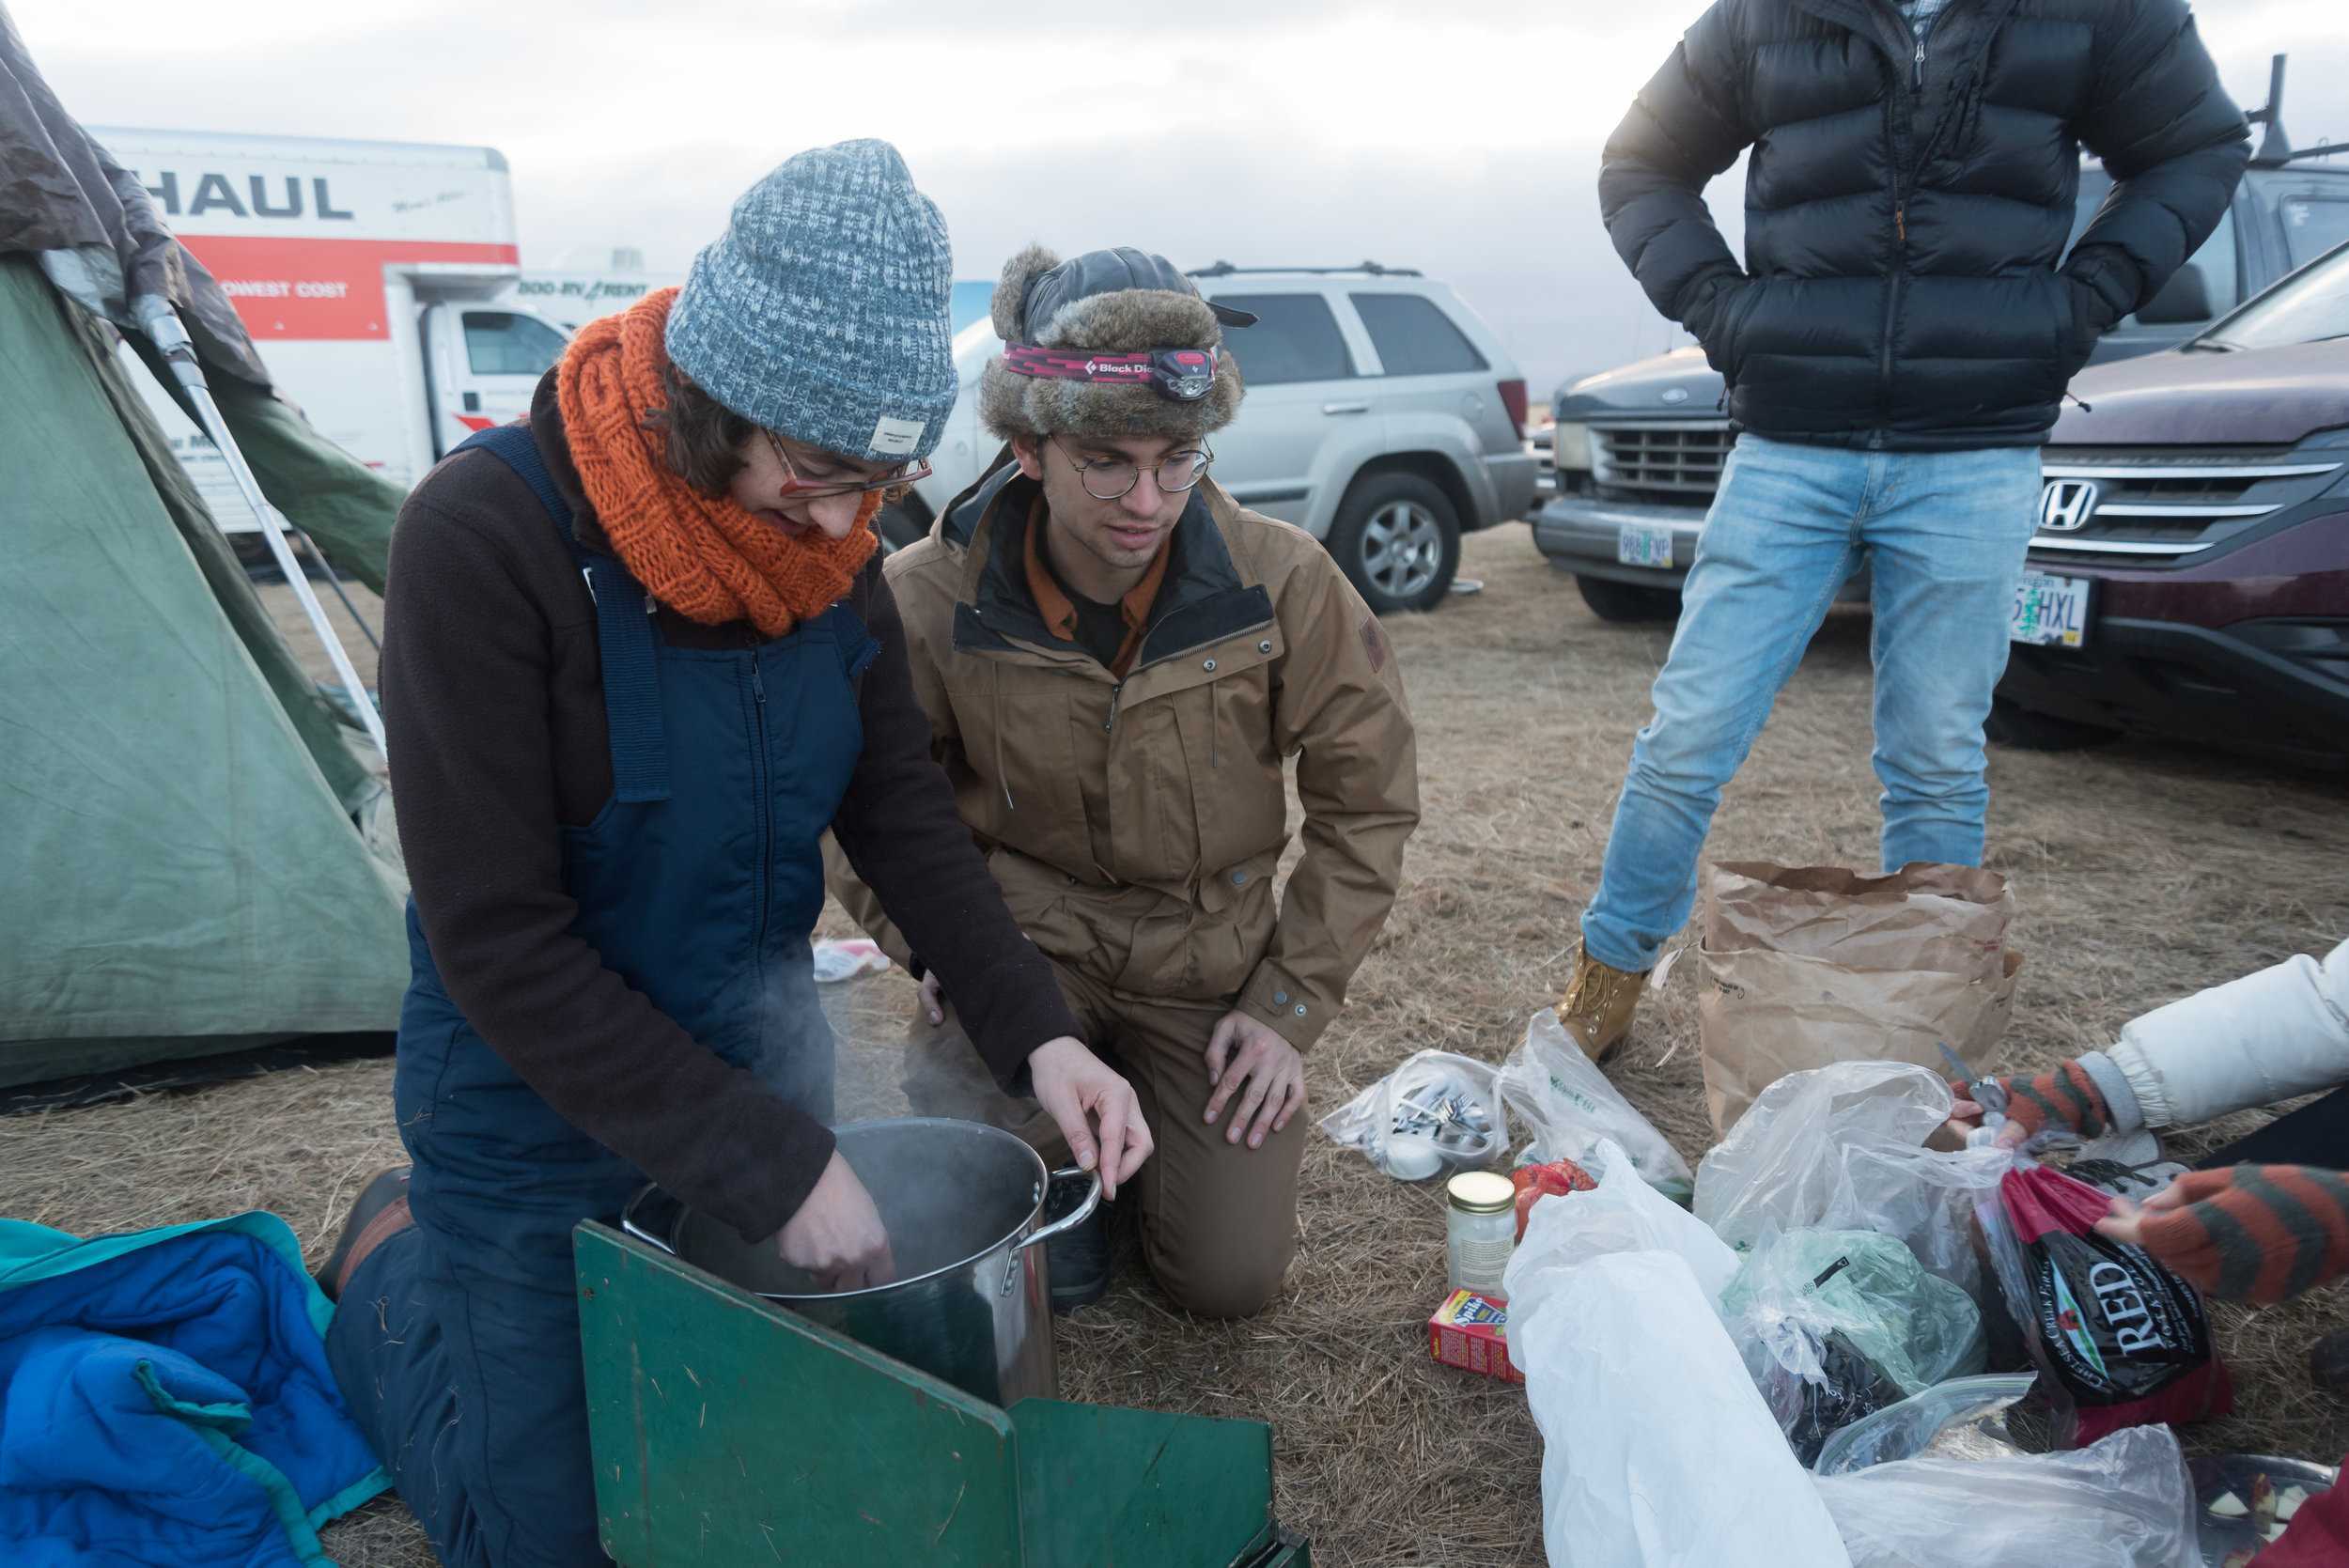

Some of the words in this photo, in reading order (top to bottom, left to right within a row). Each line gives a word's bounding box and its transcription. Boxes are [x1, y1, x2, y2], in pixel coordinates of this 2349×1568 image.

[219, 280, 291, 298] OWEST
[295, 281, 349, 299] COST
[1099, 364, 1132, 373] Black
[2036, 591, 2080, 630] HXL
[1454, 1296, 1485, 1327] Spike
[2043, 1299, 2061, 1340] CREEK
[2089, 1261, 2169, 1358] RED
[2055, 1340, 2104, 1389] CHELSEA
